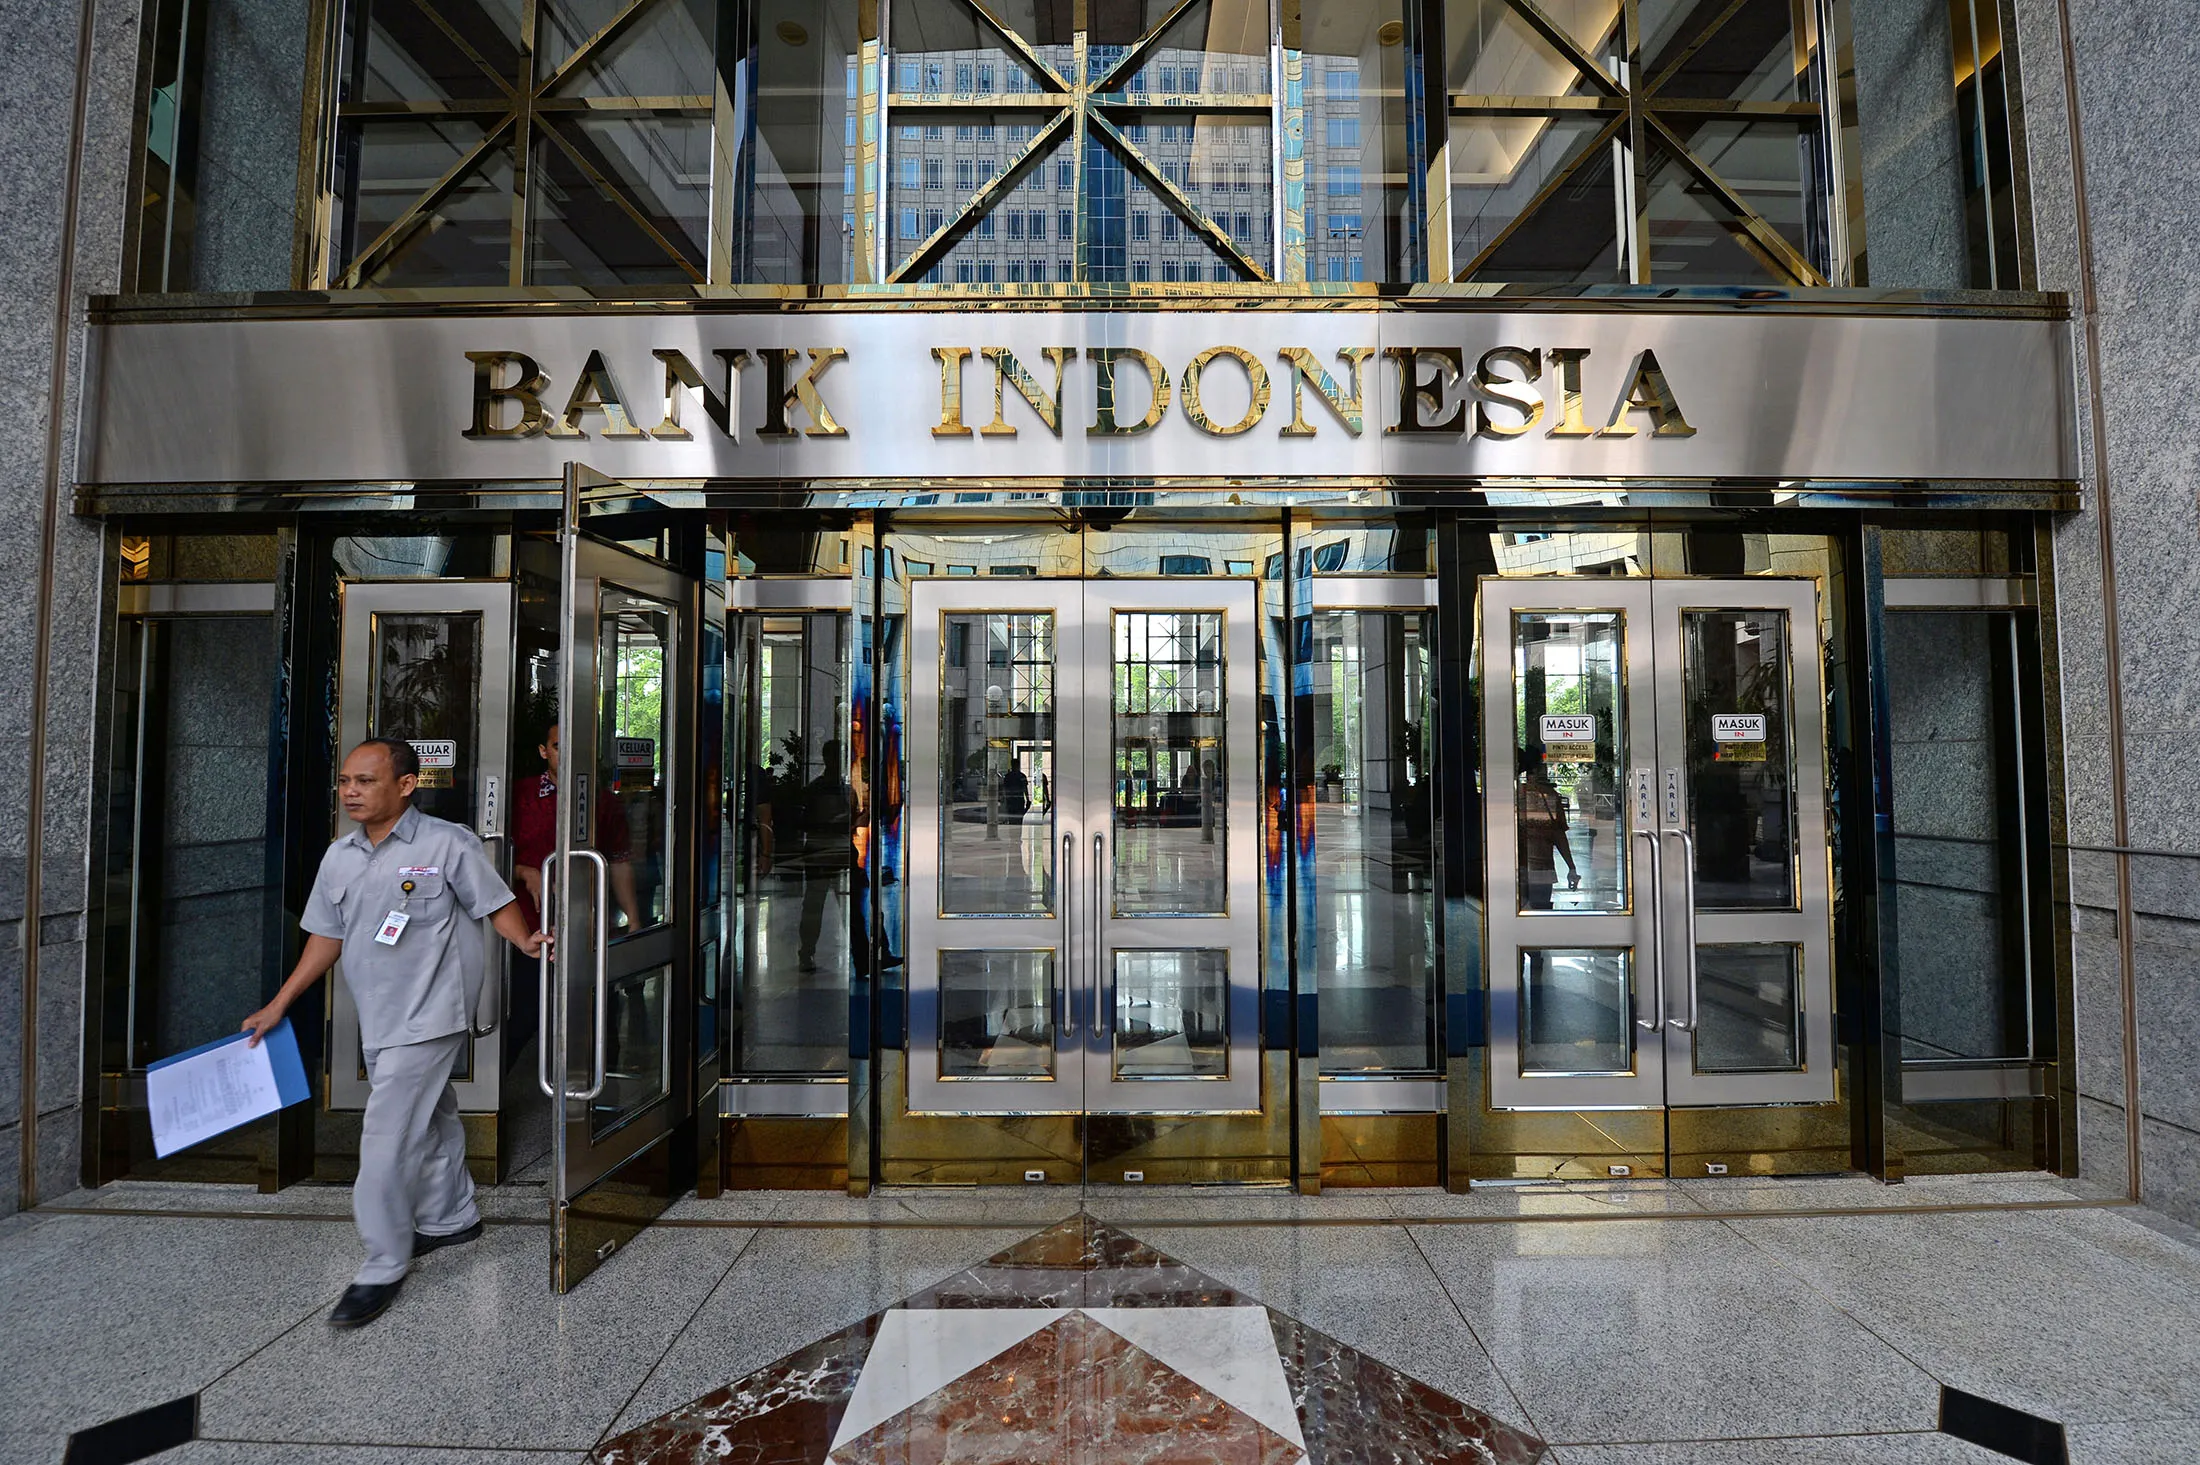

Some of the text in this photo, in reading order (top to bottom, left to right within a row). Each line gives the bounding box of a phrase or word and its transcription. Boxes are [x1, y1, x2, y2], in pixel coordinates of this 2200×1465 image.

[462, 345, 1698, 440] BANK INDONESIA
[1546, 719, 1589, 729] MASUK
[1718, 719, 1760, 729] MASUK
[415, 745, 450, 755] ELUAR
[619, 742, 651, 753] KELUAR
[1668, 773, 1676, 818] TARIK
[486, 781, 496, 827] TARIK
